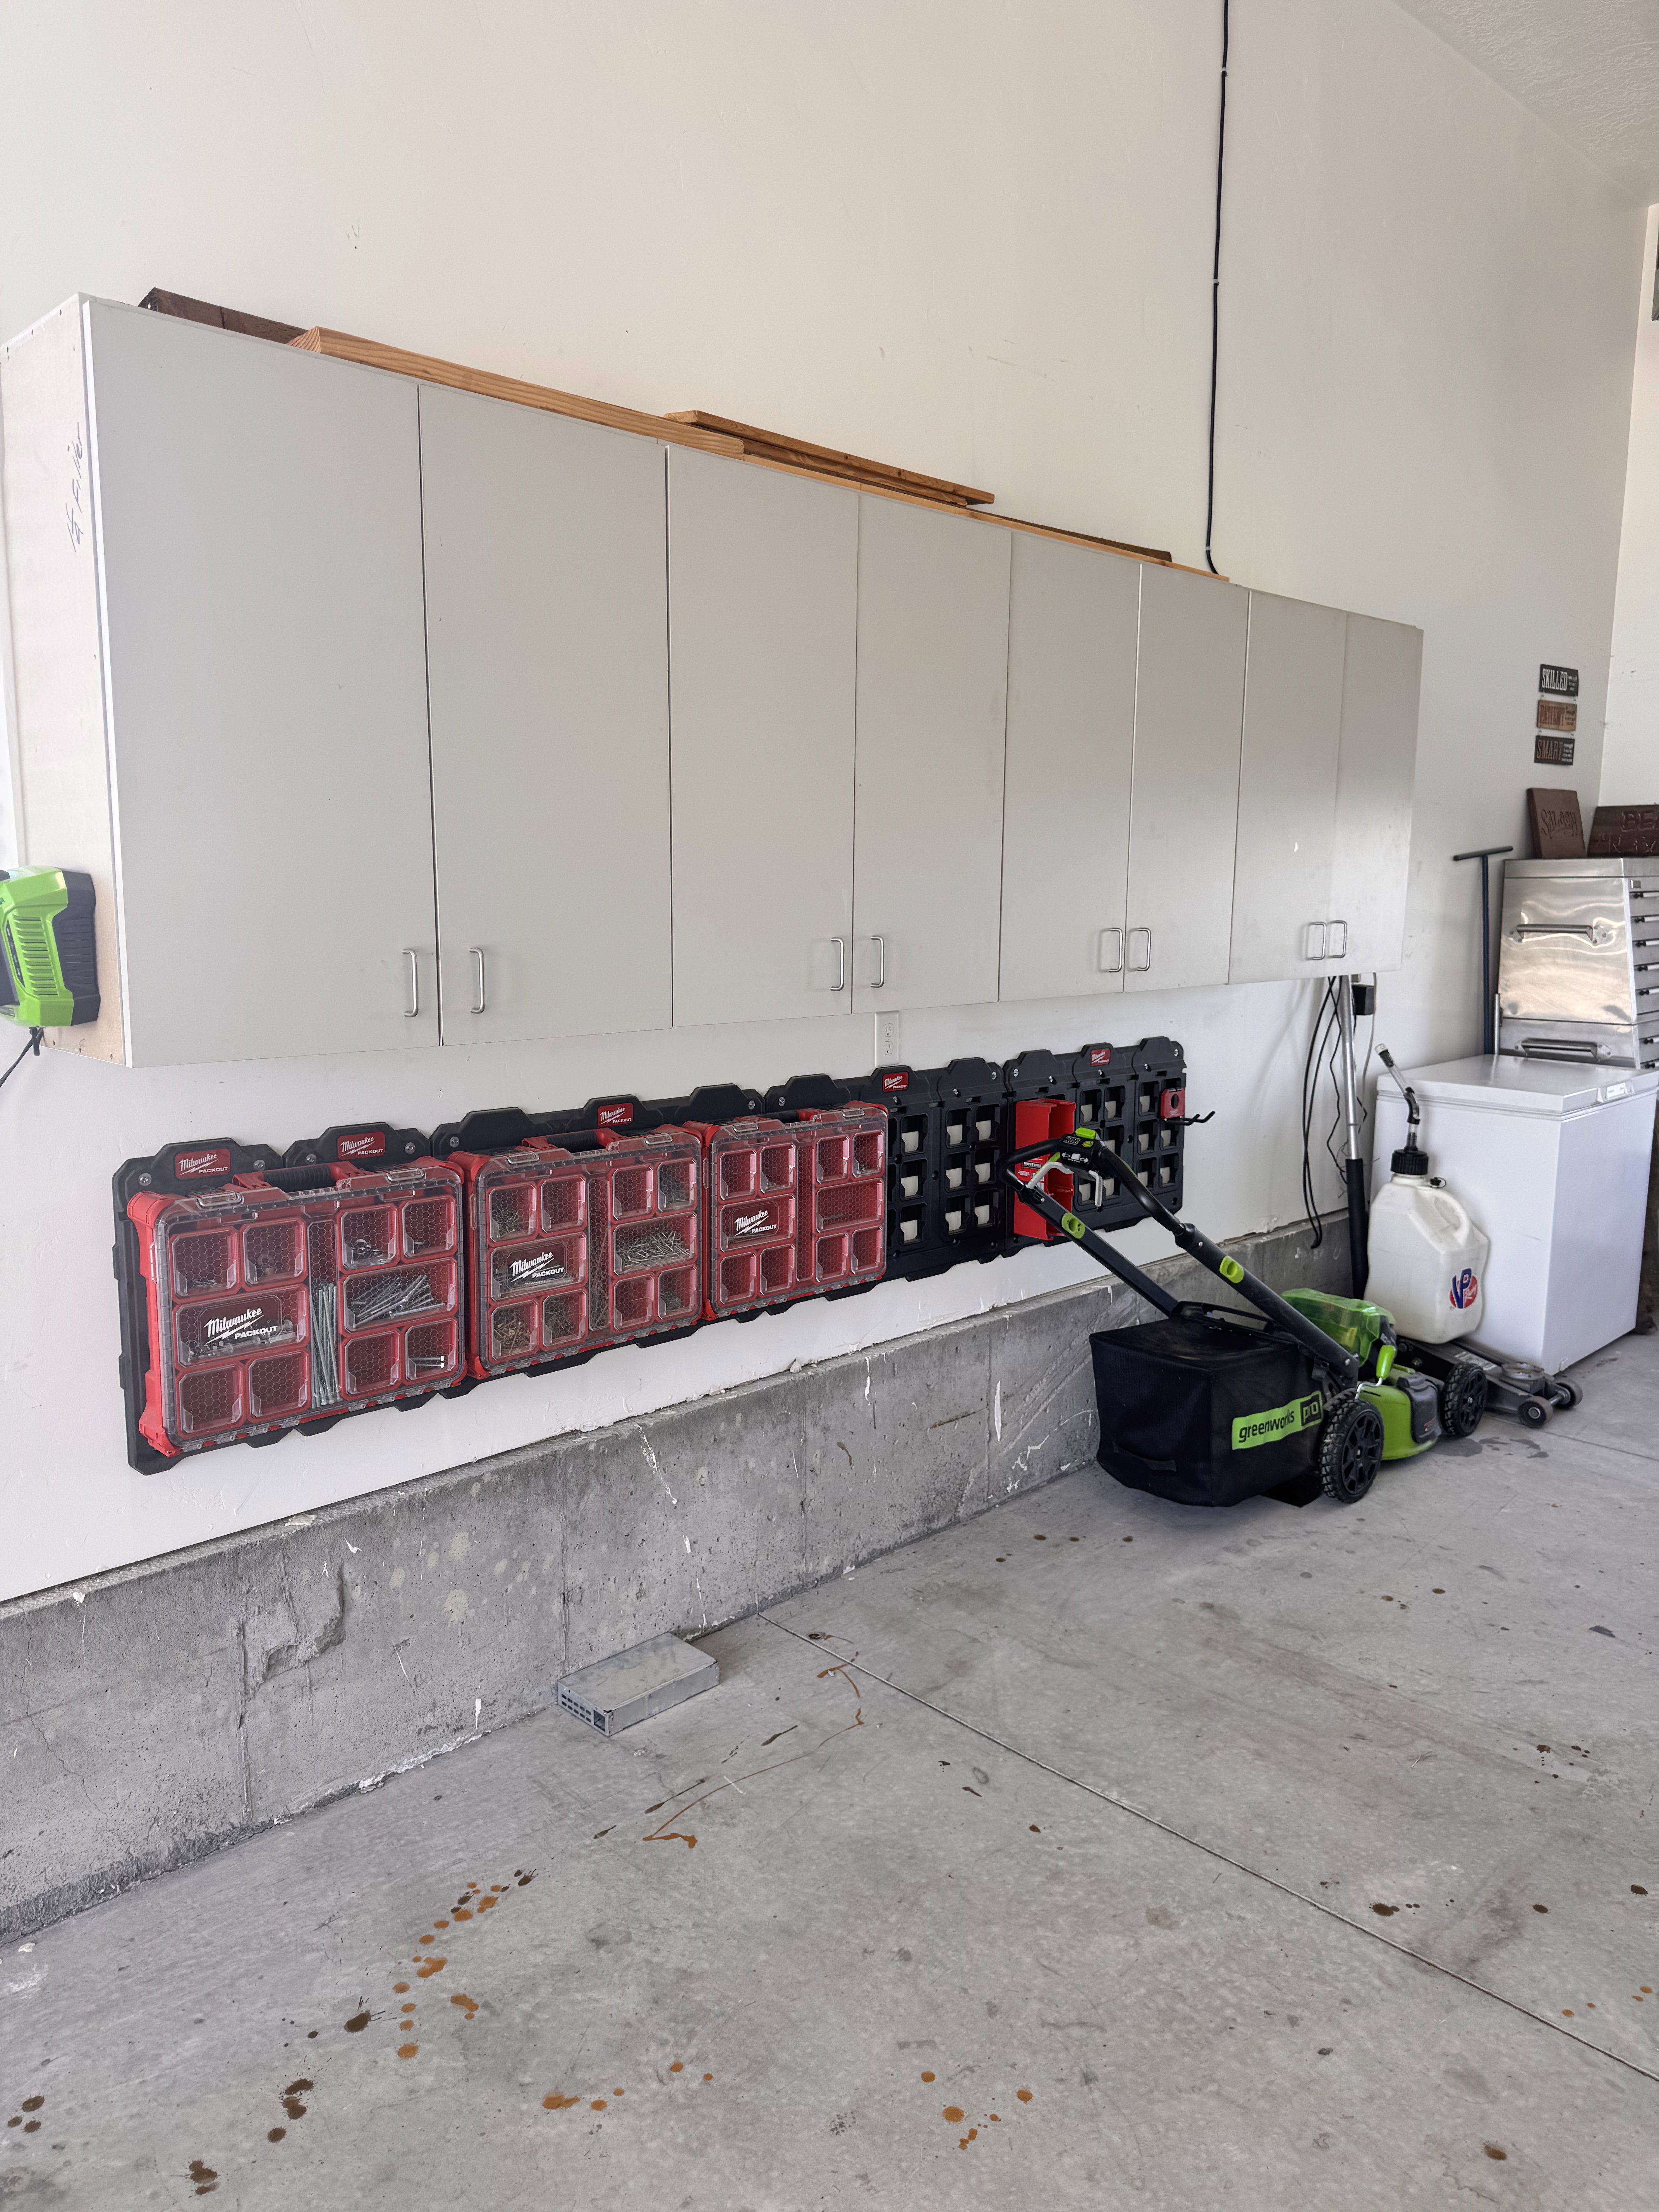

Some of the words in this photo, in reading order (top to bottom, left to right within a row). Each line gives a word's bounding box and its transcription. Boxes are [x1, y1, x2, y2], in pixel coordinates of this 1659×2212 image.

[1542, 668, 1568, 691] SKILLED
[1536, 740, 1563, 761] SMART
[600, 1107, 625, 1121] Milwaukee
[340, 1137, 374, 1152] Milwaukee
[178, 1154, 217, 1171] Milwaukee
[734, 1210, 768, 1231] Milwaukee
[751, 1224, 777, 1233] PACKOUT
[509, 1252, 553, 1277] Milwaukee
[532, 1267, 564, 1278] PACKOUT
[1451, 1267, 1472, 1309] VP
[203, 1308, 263, 1338] Milwaukee
[234, 1326, 278, 1339] PACKOUT
[1238, 1409, 1295, 1443] greenworks
[1303, 1401, 1319, 1423] pro
